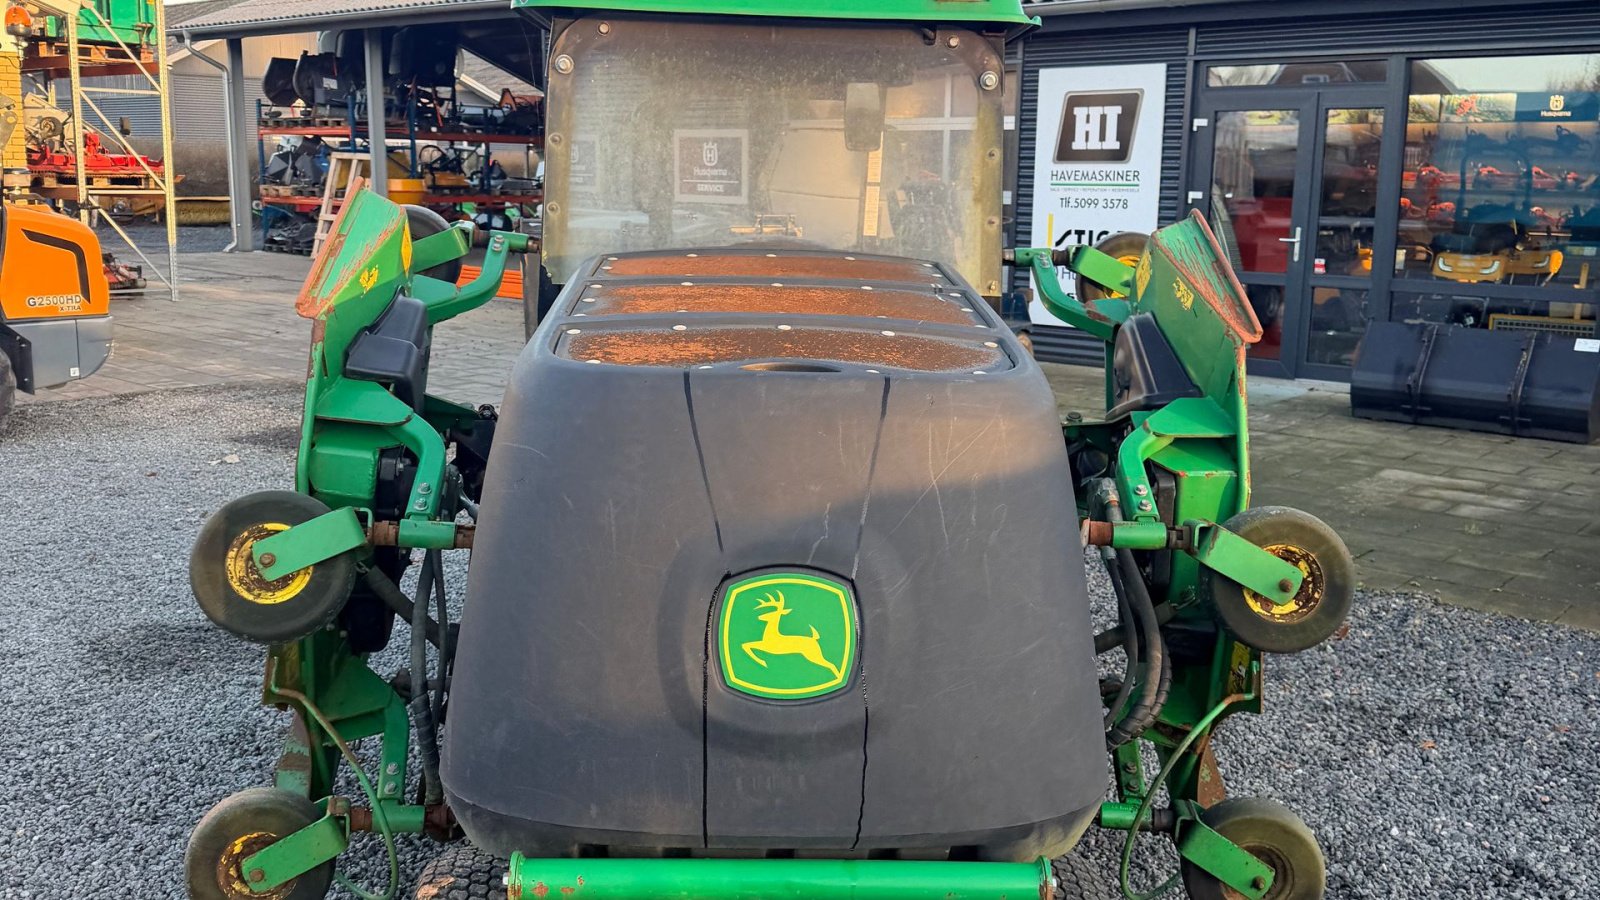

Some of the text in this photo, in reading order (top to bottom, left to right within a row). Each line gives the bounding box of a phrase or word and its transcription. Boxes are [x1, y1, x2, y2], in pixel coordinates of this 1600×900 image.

[1071, 105, 1122, 150] HI
[1050, 169, 1140, 181] HAVEMASKINER
[697, 183, 724, 192] SERVICE
[1102, 199, 1129, 209] 3578
[1055, 230, 1126, 247] STI
[27, 294, 81, 306] G2500HD
